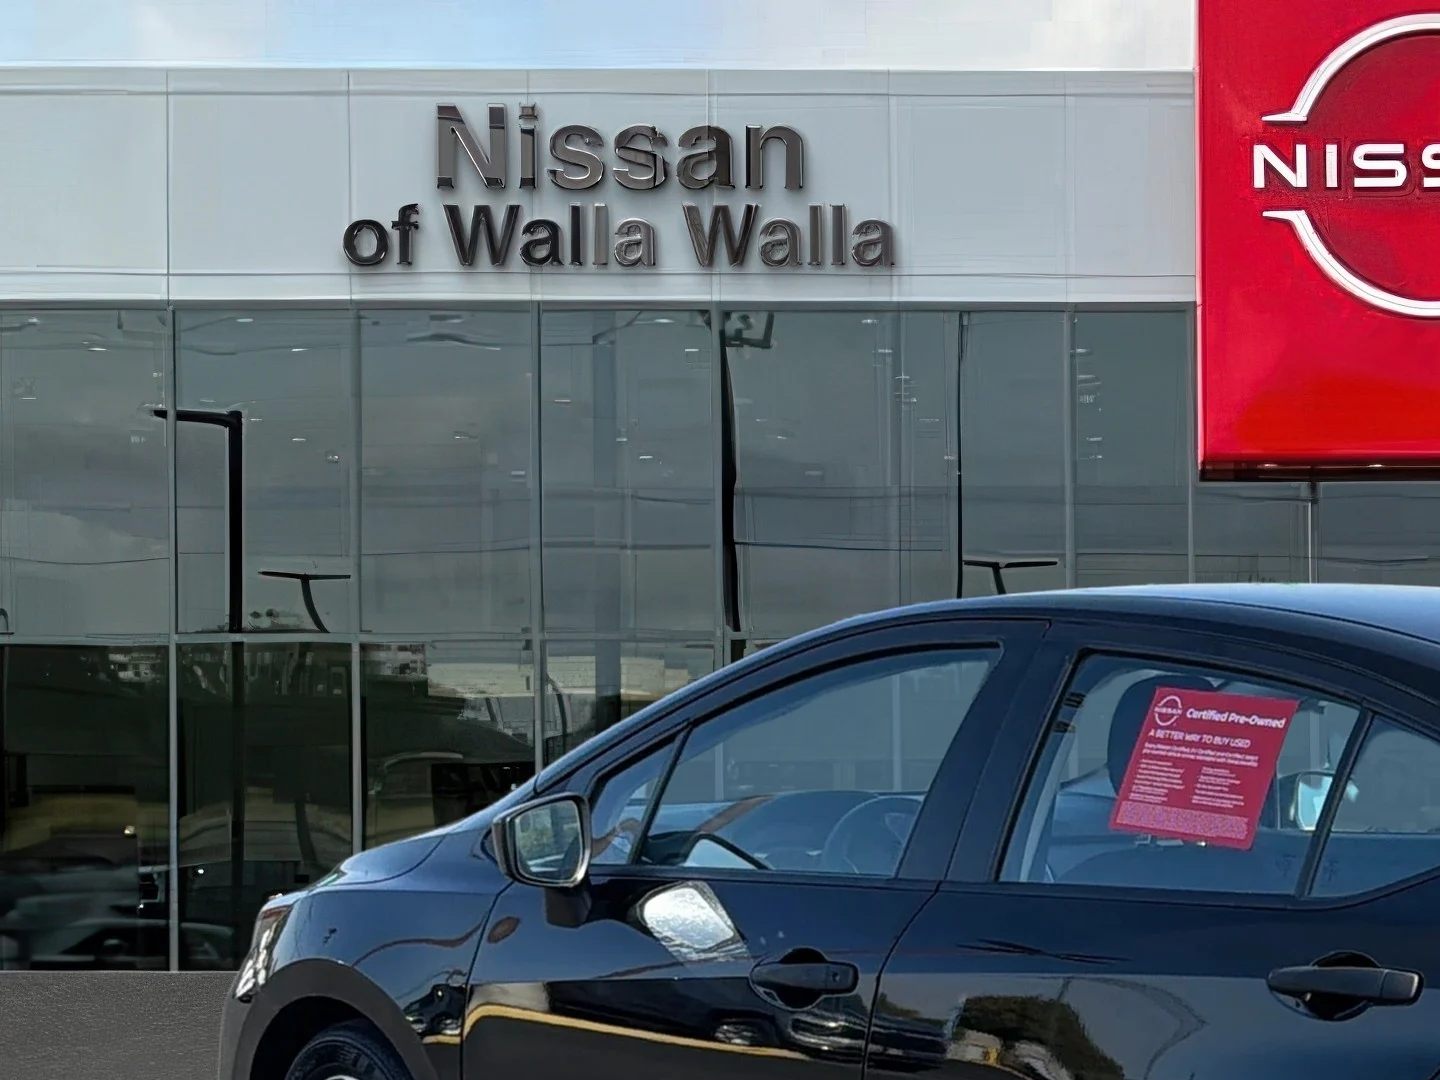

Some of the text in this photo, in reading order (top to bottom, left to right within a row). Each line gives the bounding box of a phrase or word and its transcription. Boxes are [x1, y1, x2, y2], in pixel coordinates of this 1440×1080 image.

[436, 101, 804, 190] Nissan
[343, 202, 896, 267] of Walla Walla
[1155, 729, 1184, 740] BETTER
[1201, 734, 1213, 744] TO
[1213, 736, 1229, 746] BUY
[1186, 708, 1286, 728] Certified Pre-Owned
